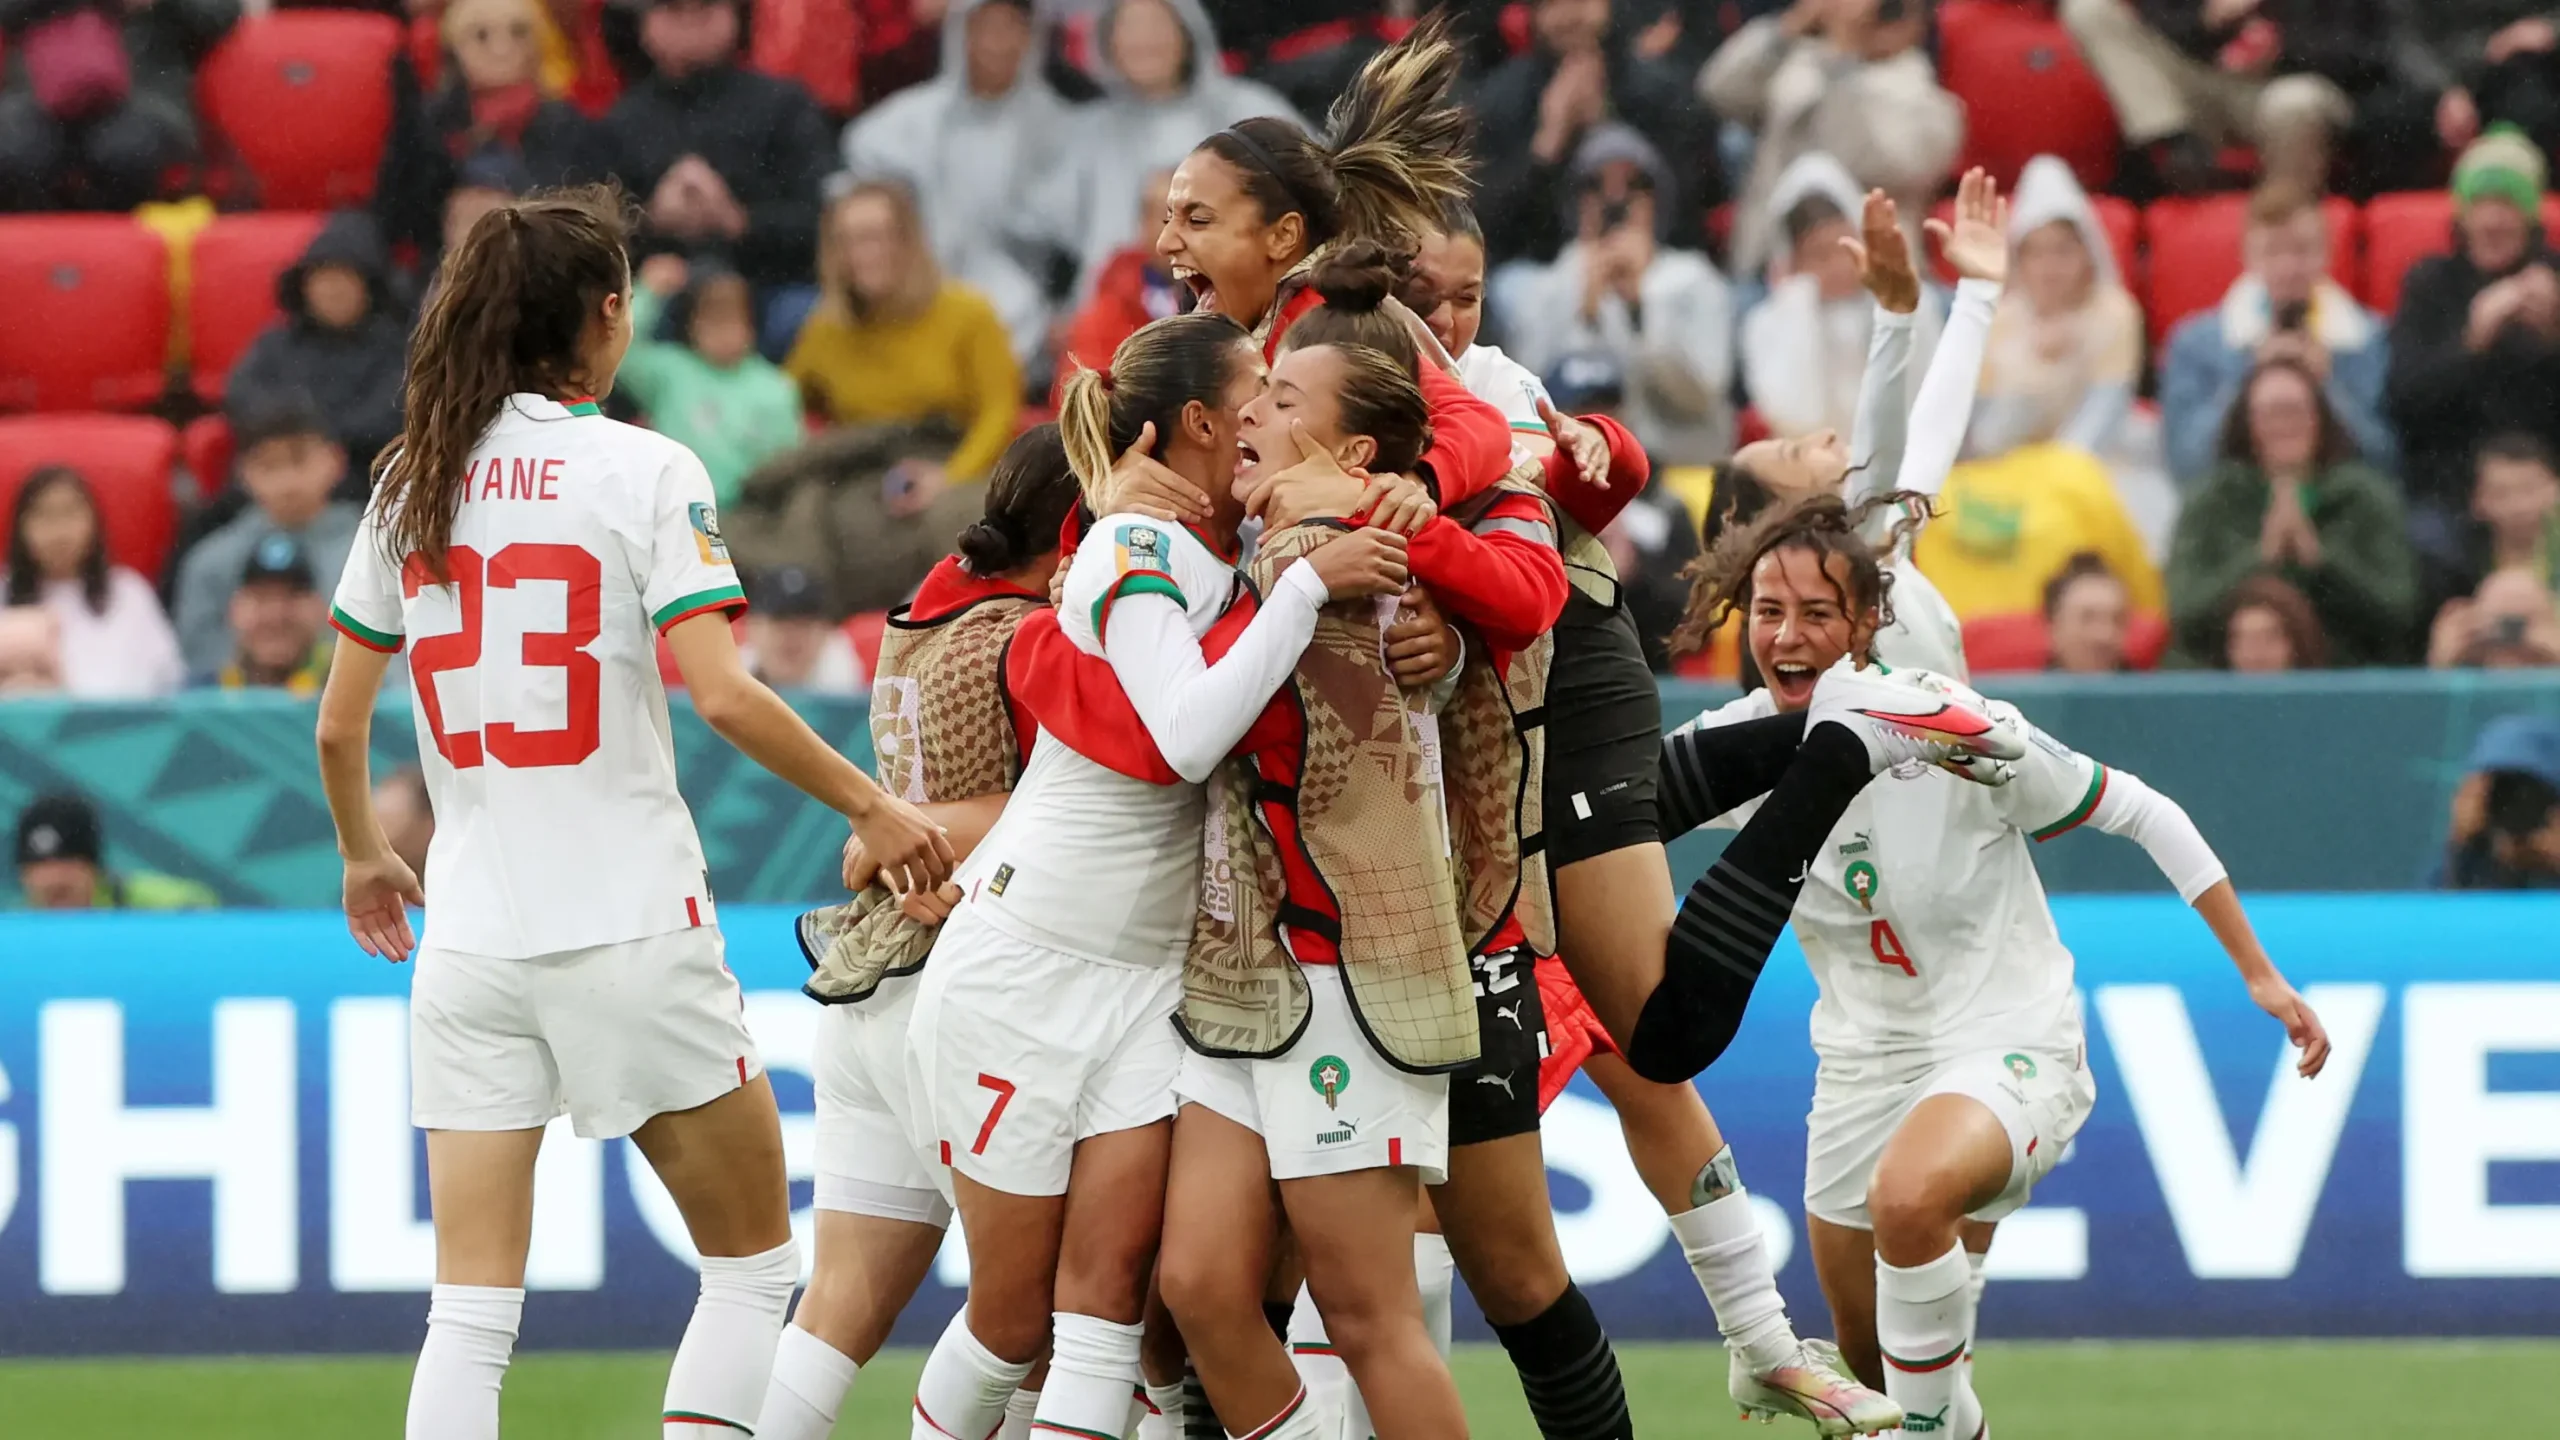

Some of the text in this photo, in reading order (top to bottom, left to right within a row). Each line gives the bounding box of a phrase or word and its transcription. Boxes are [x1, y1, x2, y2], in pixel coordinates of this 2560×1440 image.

[401, 542, 602, 769] 23
[1870, 919, 1918, 978] 4
[970, 1072, 1016, 1155] 7
[1316, 1129, 1352, 1145] PUMA
[1983, 982, 2560, 1281] VE
